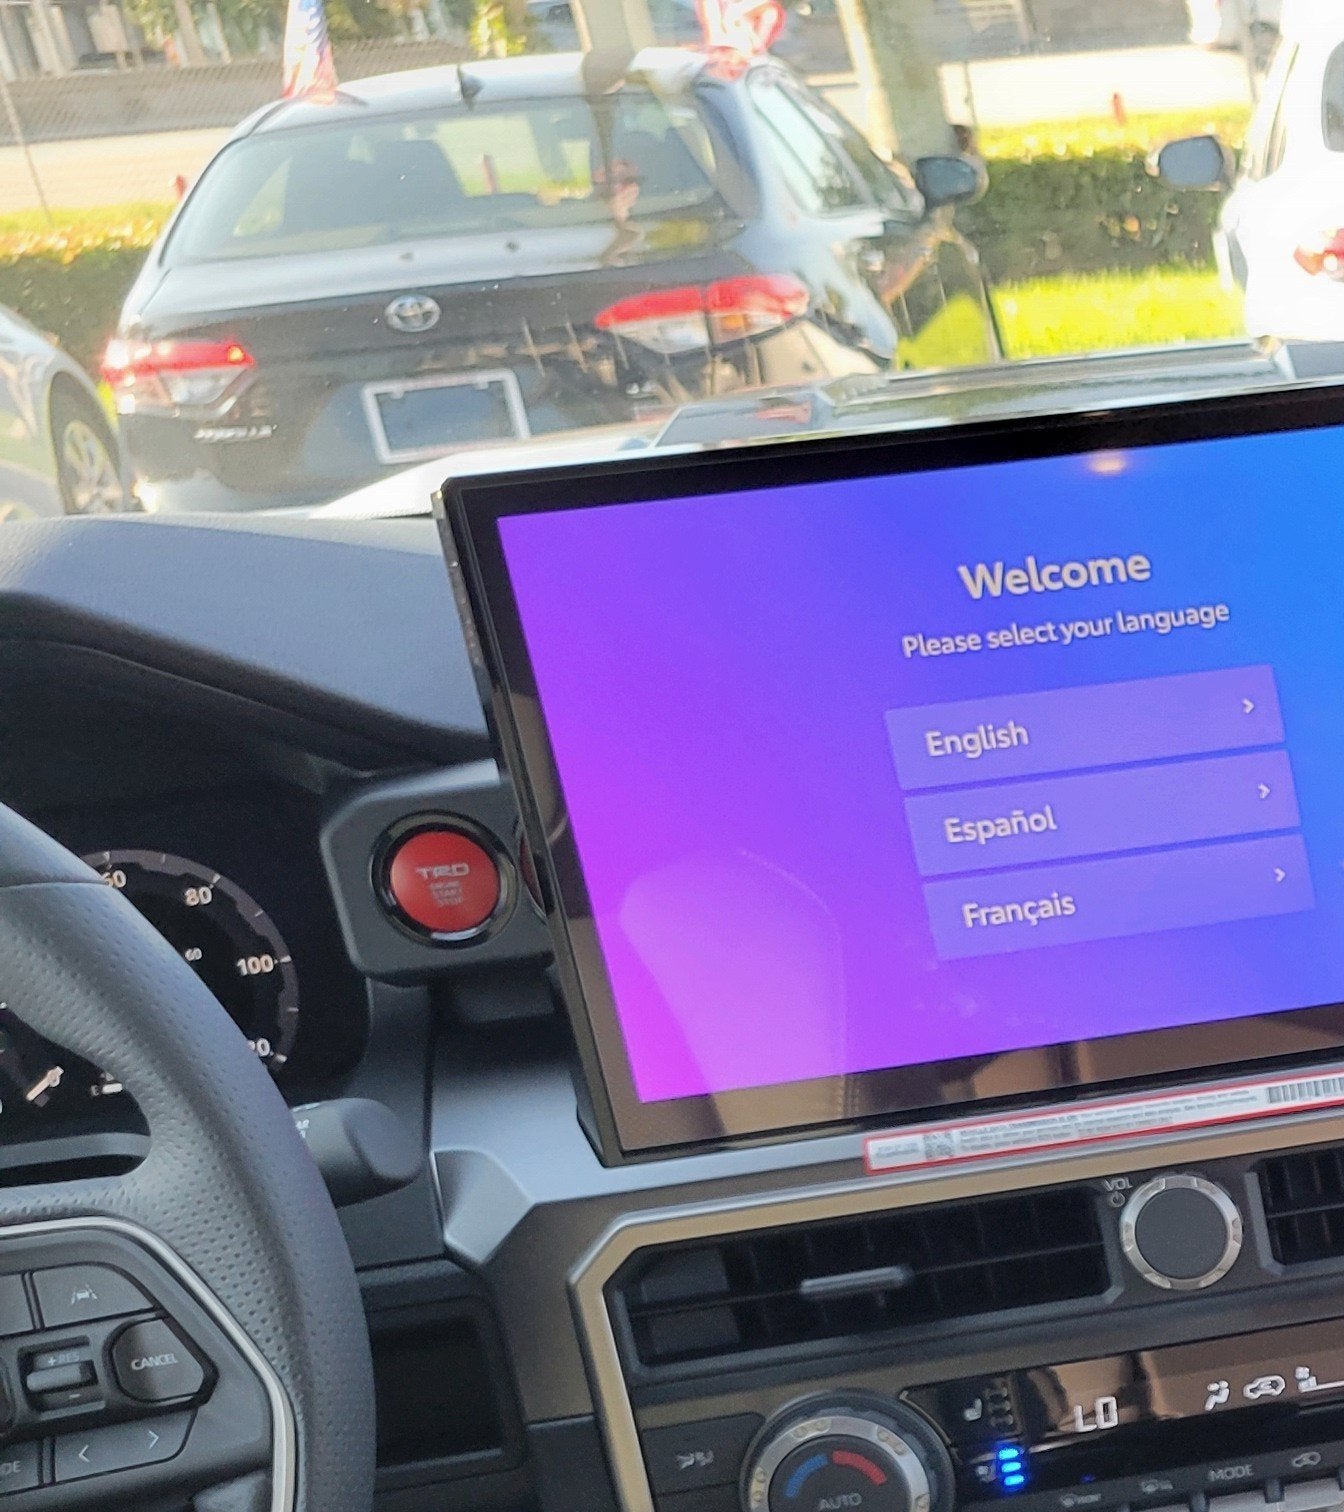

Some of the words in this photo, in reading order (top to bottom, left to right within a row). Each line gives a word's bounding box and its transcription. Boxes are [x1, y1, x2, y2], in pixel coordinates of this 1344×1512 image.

[958, 552, 1152, 600] Welcome
[901, 632, 982, 659] Please
[986, 620, 1057, 648] select
[1060, 618, 1113, 645] your
[1117, 603, 1231, 634] language
[925, 721, 1030, 759] English
[943, 804, 1058, 846] Español
[416, 862, 469, 880] TRD
[184, 886, 212, 906] 80
[962, 892, 1077, 929] Français
[237, 954, 275, 976] 100
[1104, 1176, 1134, 1192] VOL
[131, 1353, 178, 1371] CANCEL
[1073, 1396, 1118, 1432] LO
[1208, 1463, 1253, 1481] MODE
[817, 1491, 863, 1512] AUTO
